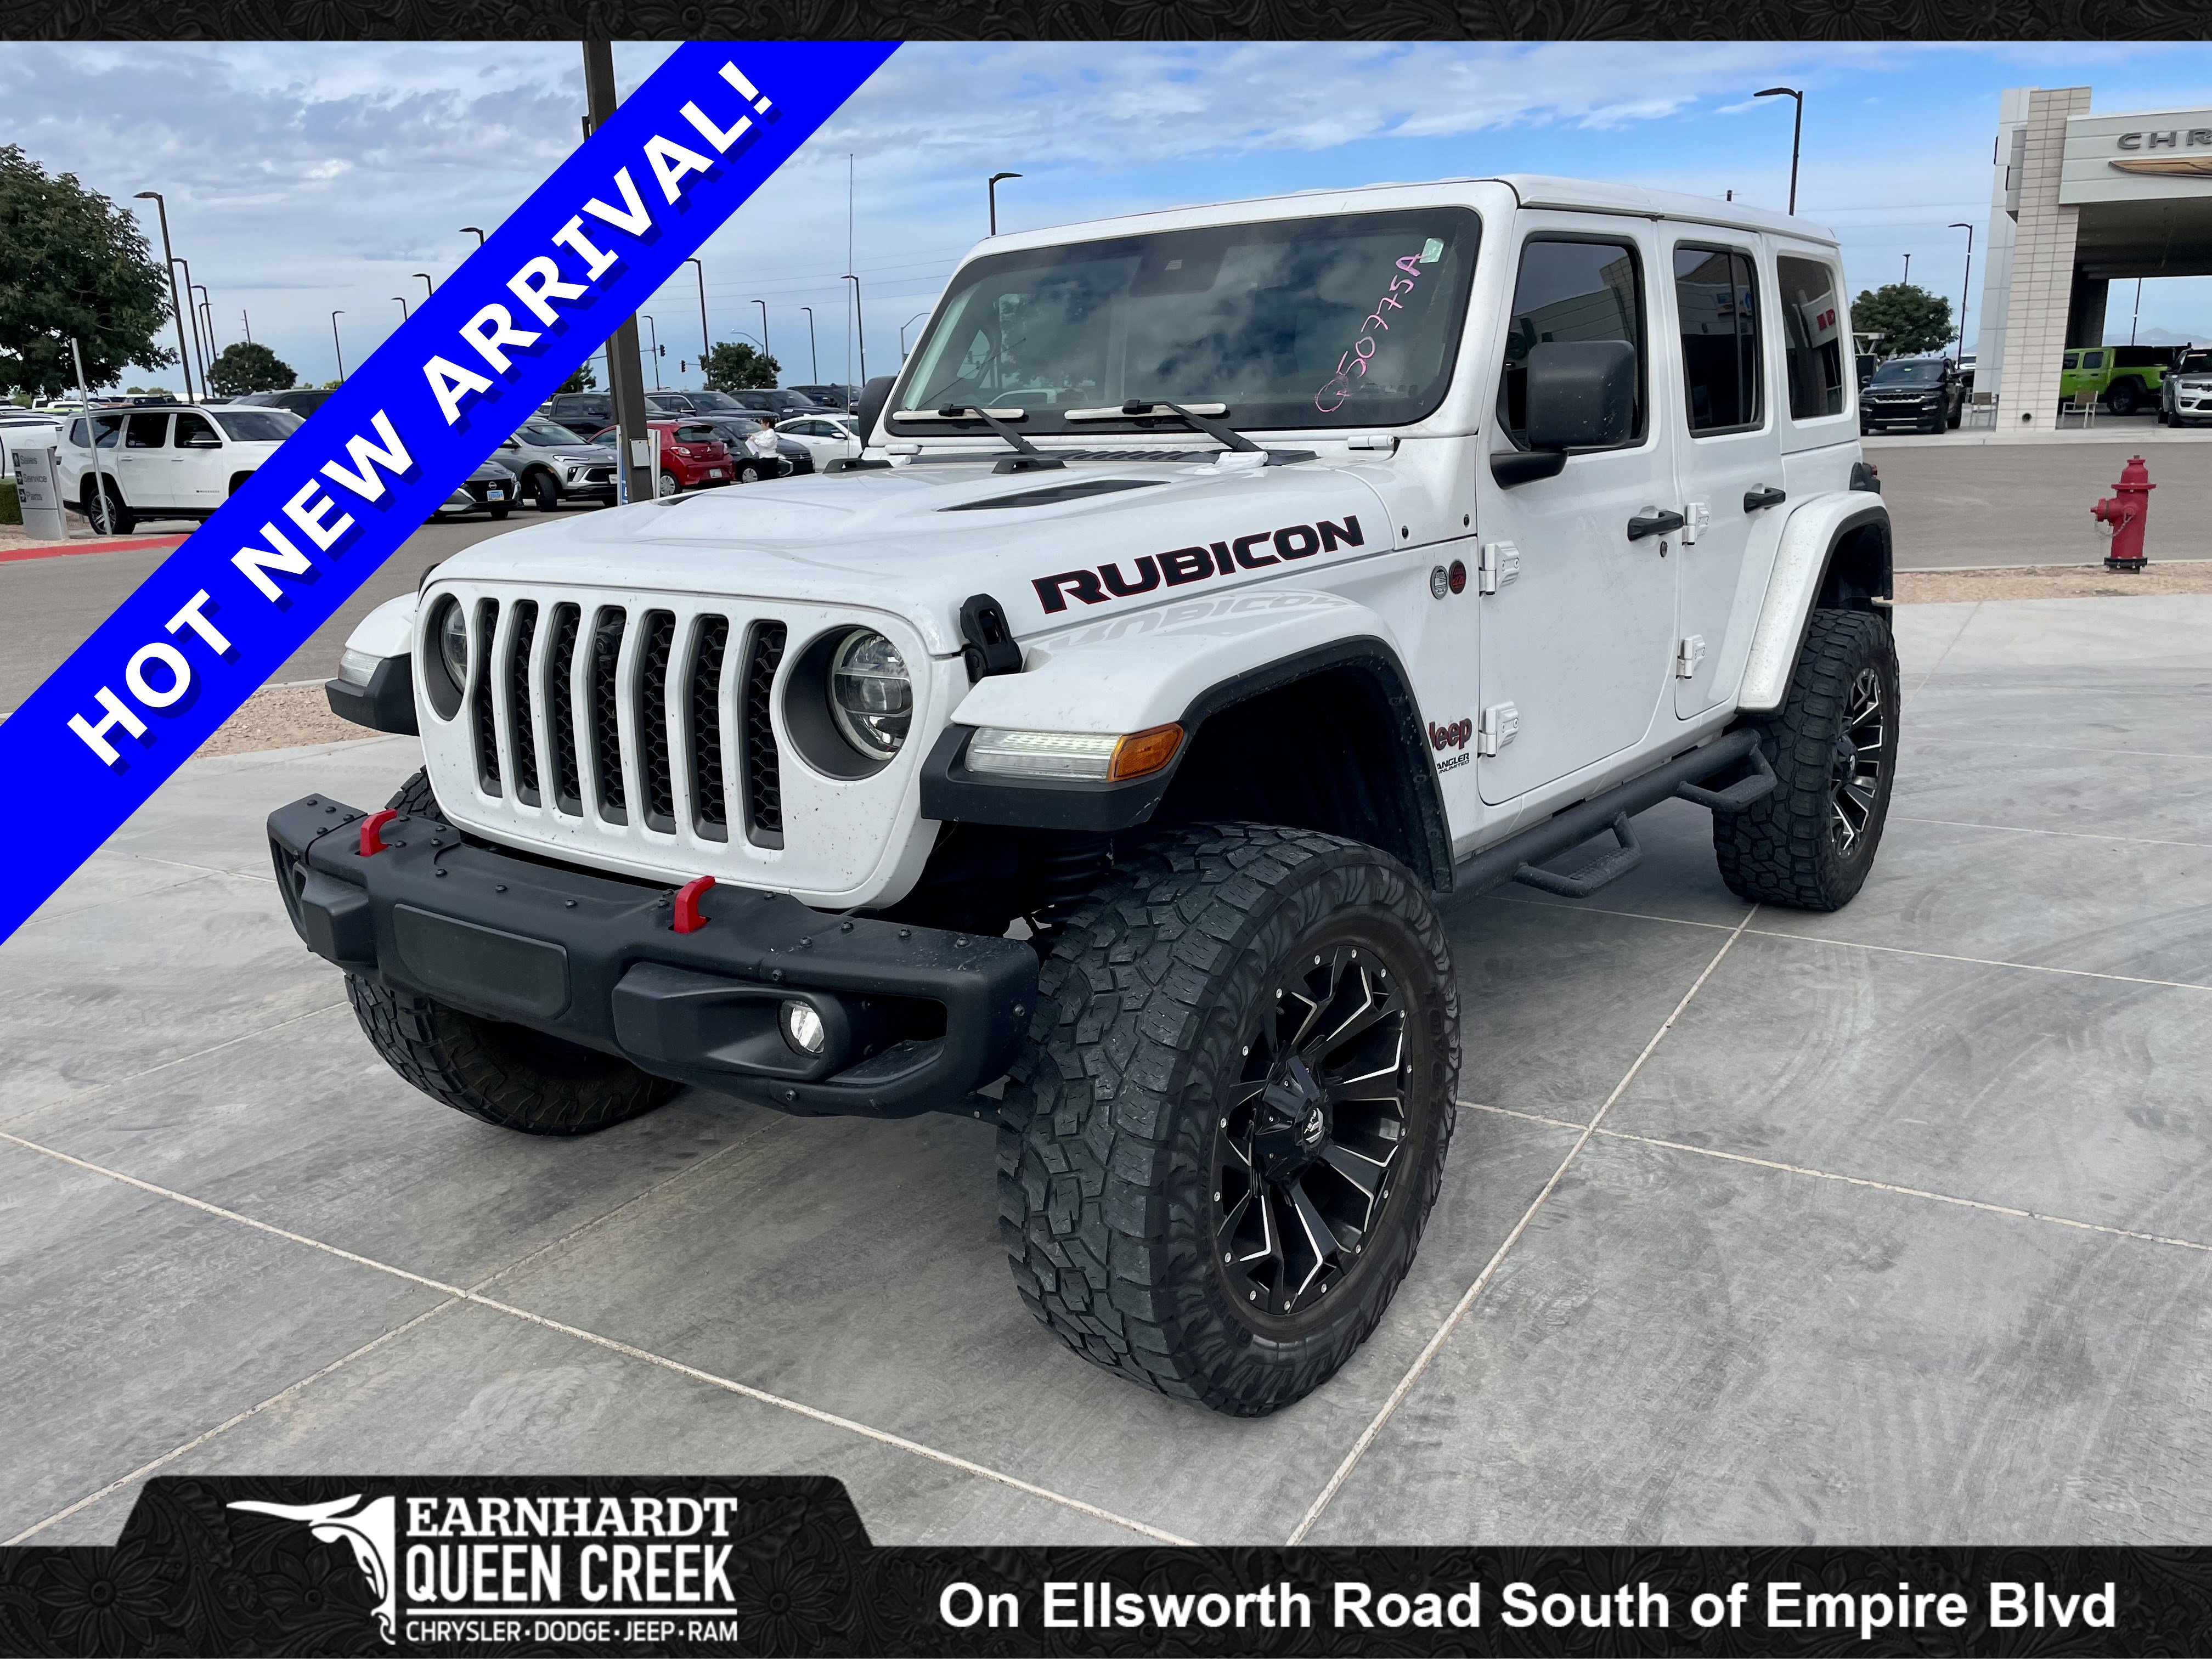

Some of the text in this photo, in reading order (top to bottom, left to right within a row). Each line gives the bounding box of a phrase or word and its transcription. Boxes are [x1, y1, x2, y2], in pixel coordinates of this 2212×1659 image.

[23, 473, 47, 483] Service
[1031, 515, 1365, 614] RUBICON
[1437, 752, 1470, 770] ANGLER
